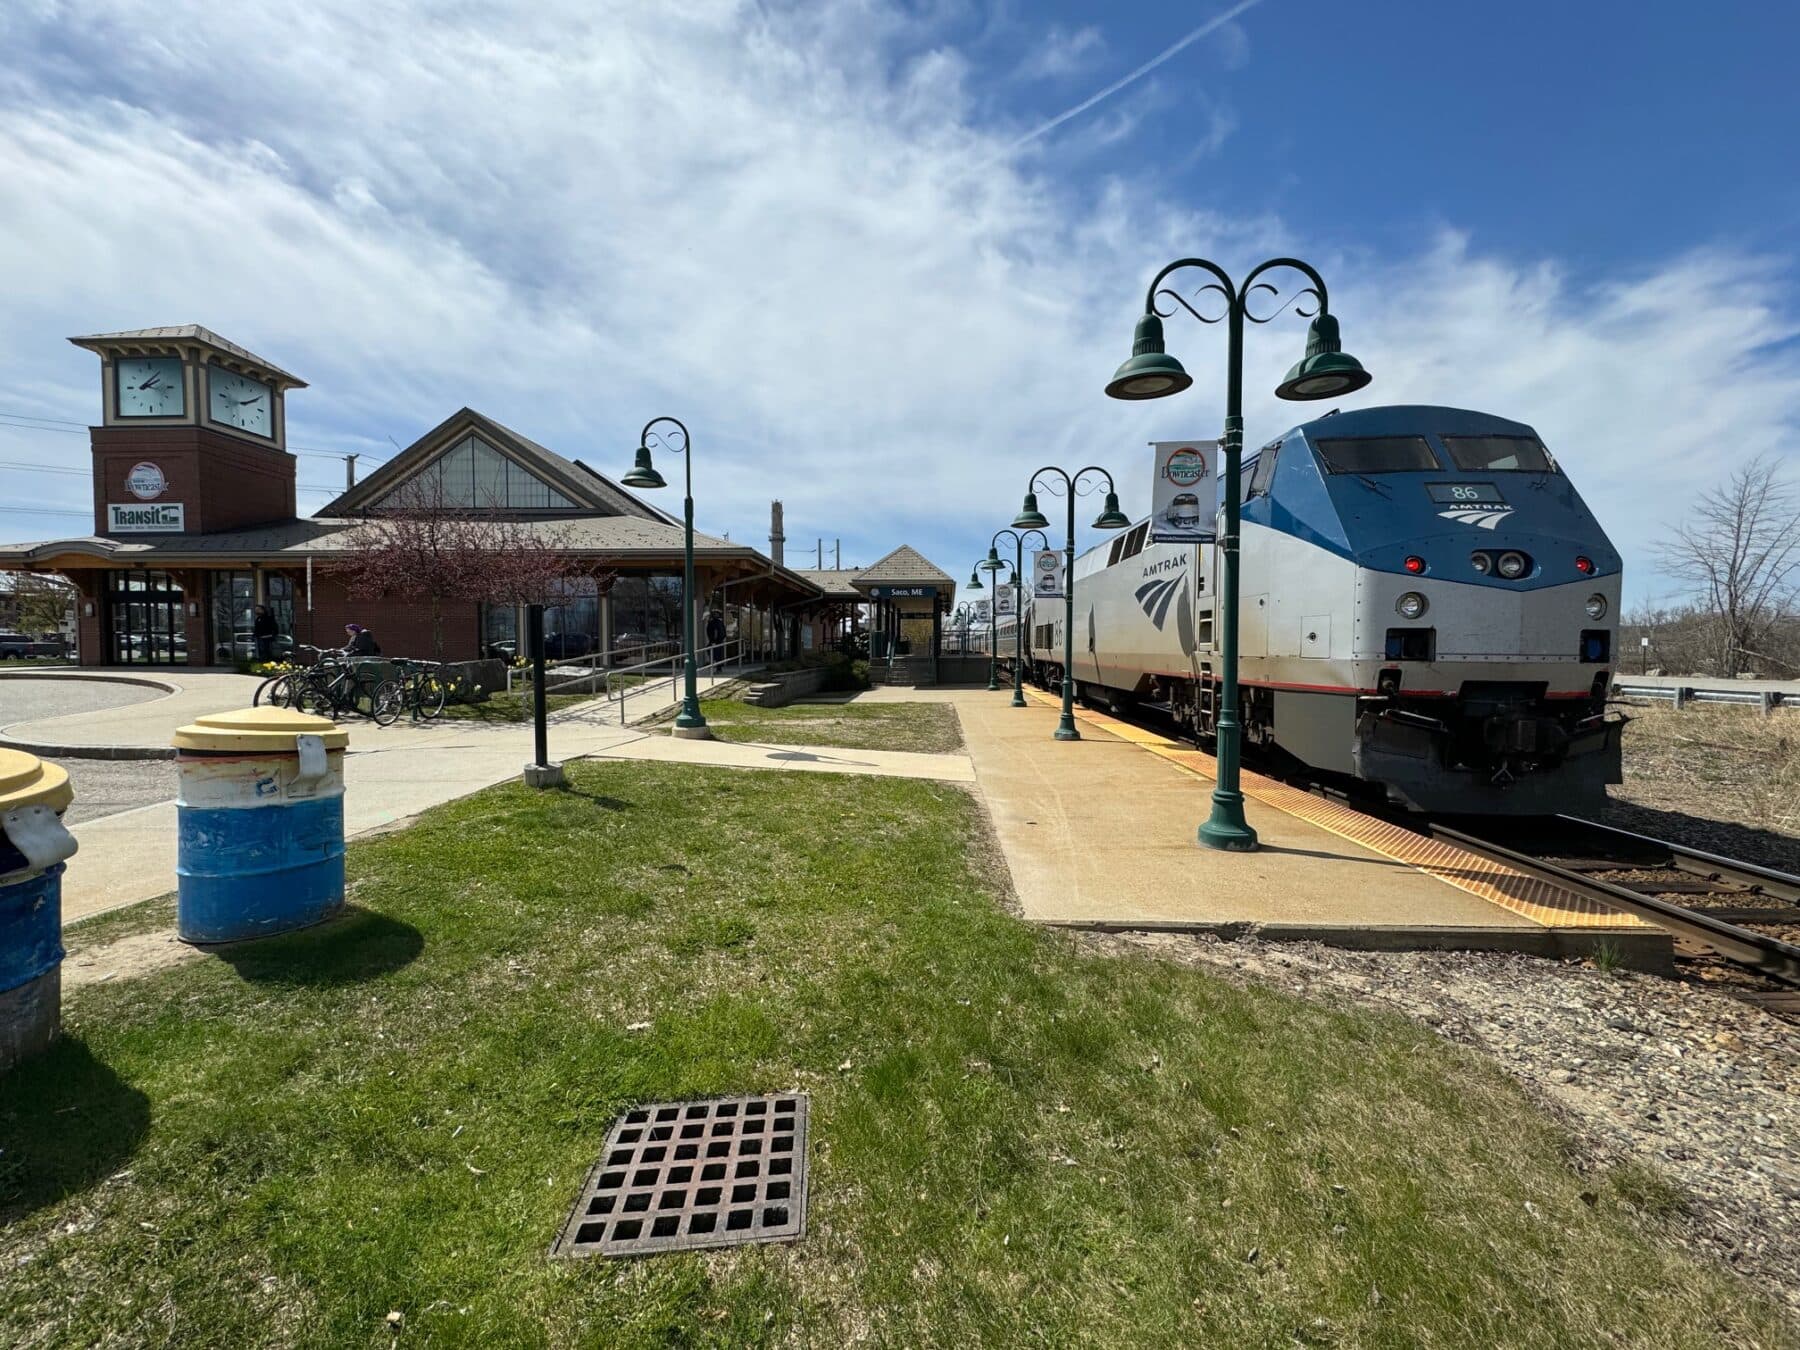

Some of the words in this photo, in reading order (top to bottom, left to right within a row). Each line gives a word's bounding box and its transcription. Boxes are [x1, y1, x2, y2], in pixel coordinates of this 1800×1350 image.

[1452, 486, 1479, 500] 86
[112, 506, 160, 525] Transit
[1142, 553, 1188, 578] AMTRAK
[891, 588, 910, 597] Saco,
[911, 588, 924, 596] ME
[1054, 619, 1063, 647] 86
